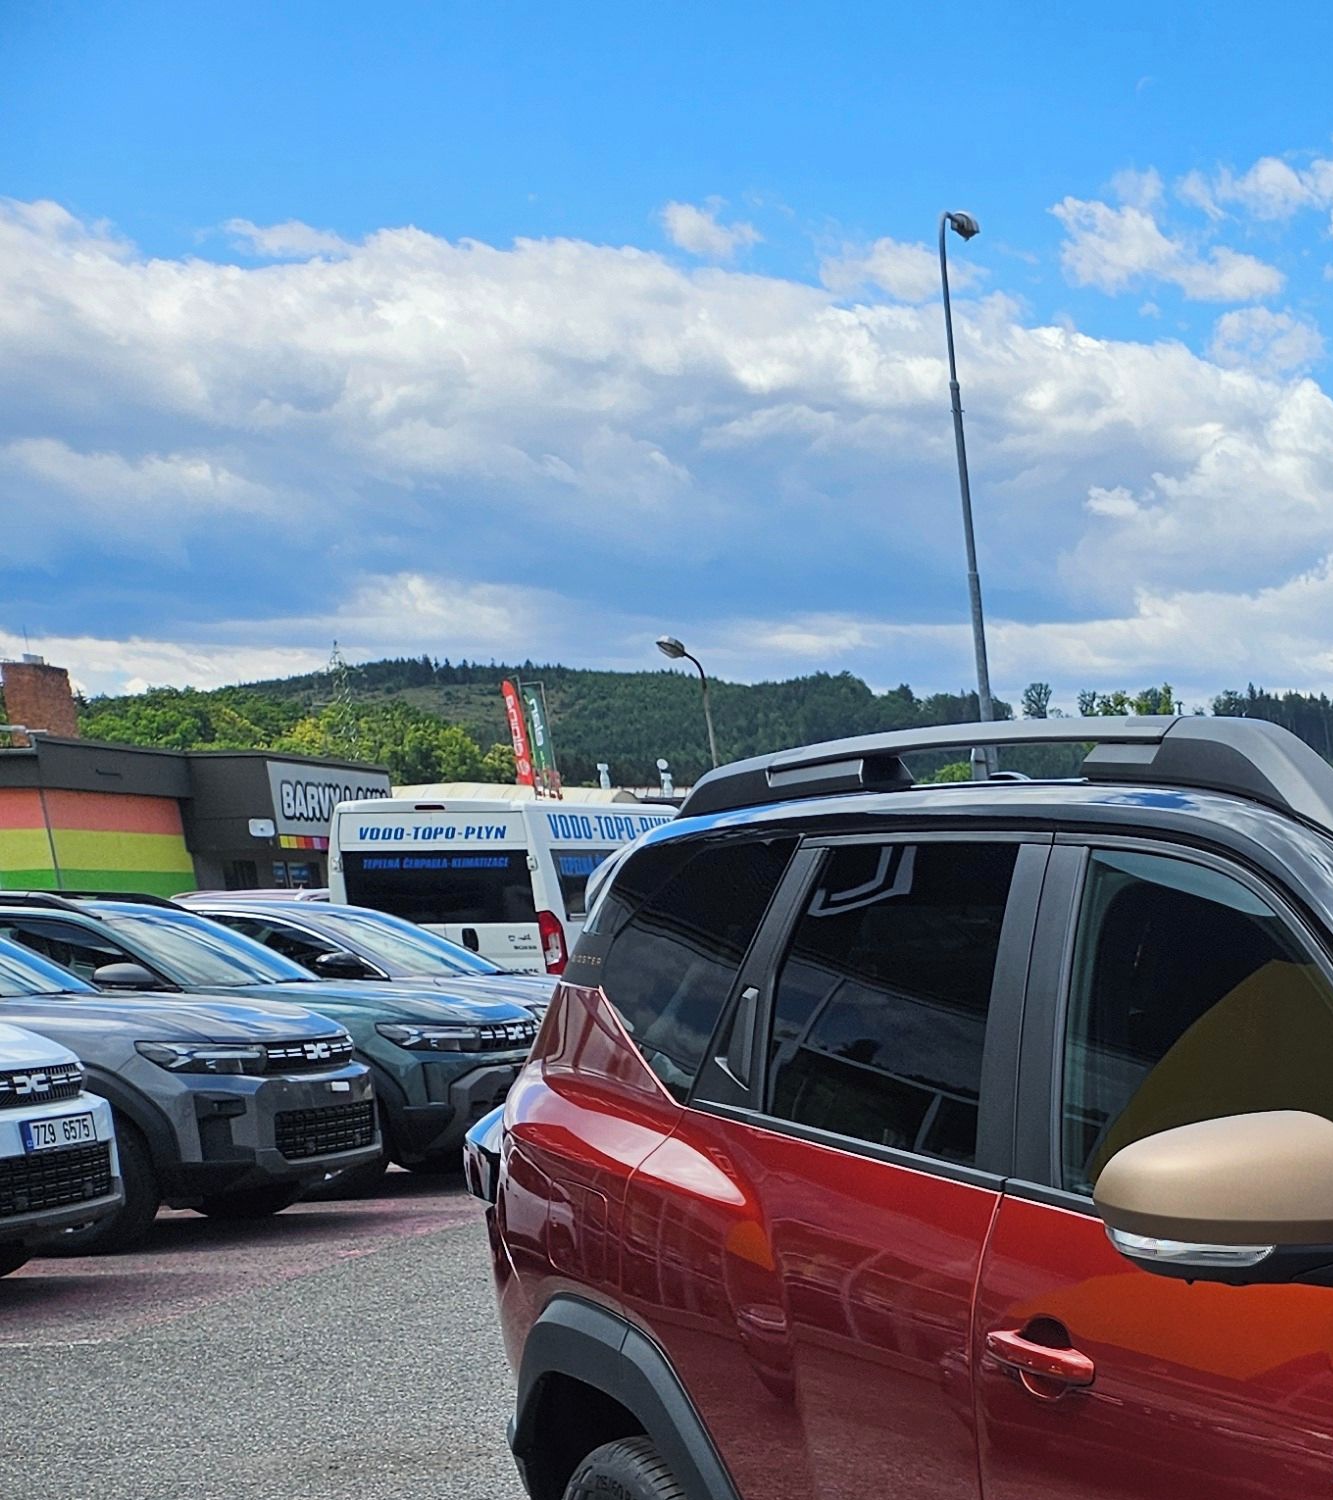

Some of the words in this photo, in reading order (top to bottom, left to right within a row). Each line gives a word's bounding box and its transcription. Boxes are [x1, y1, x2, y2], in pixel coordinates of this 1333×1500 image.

[280, 780, 342, 823] BARVY
[359, 825, 507, 840] VODO-TOPO-PLYN
[33, 1124, 56, 1146] 7Z9
[63, 1118, 90, 1140] 6575
